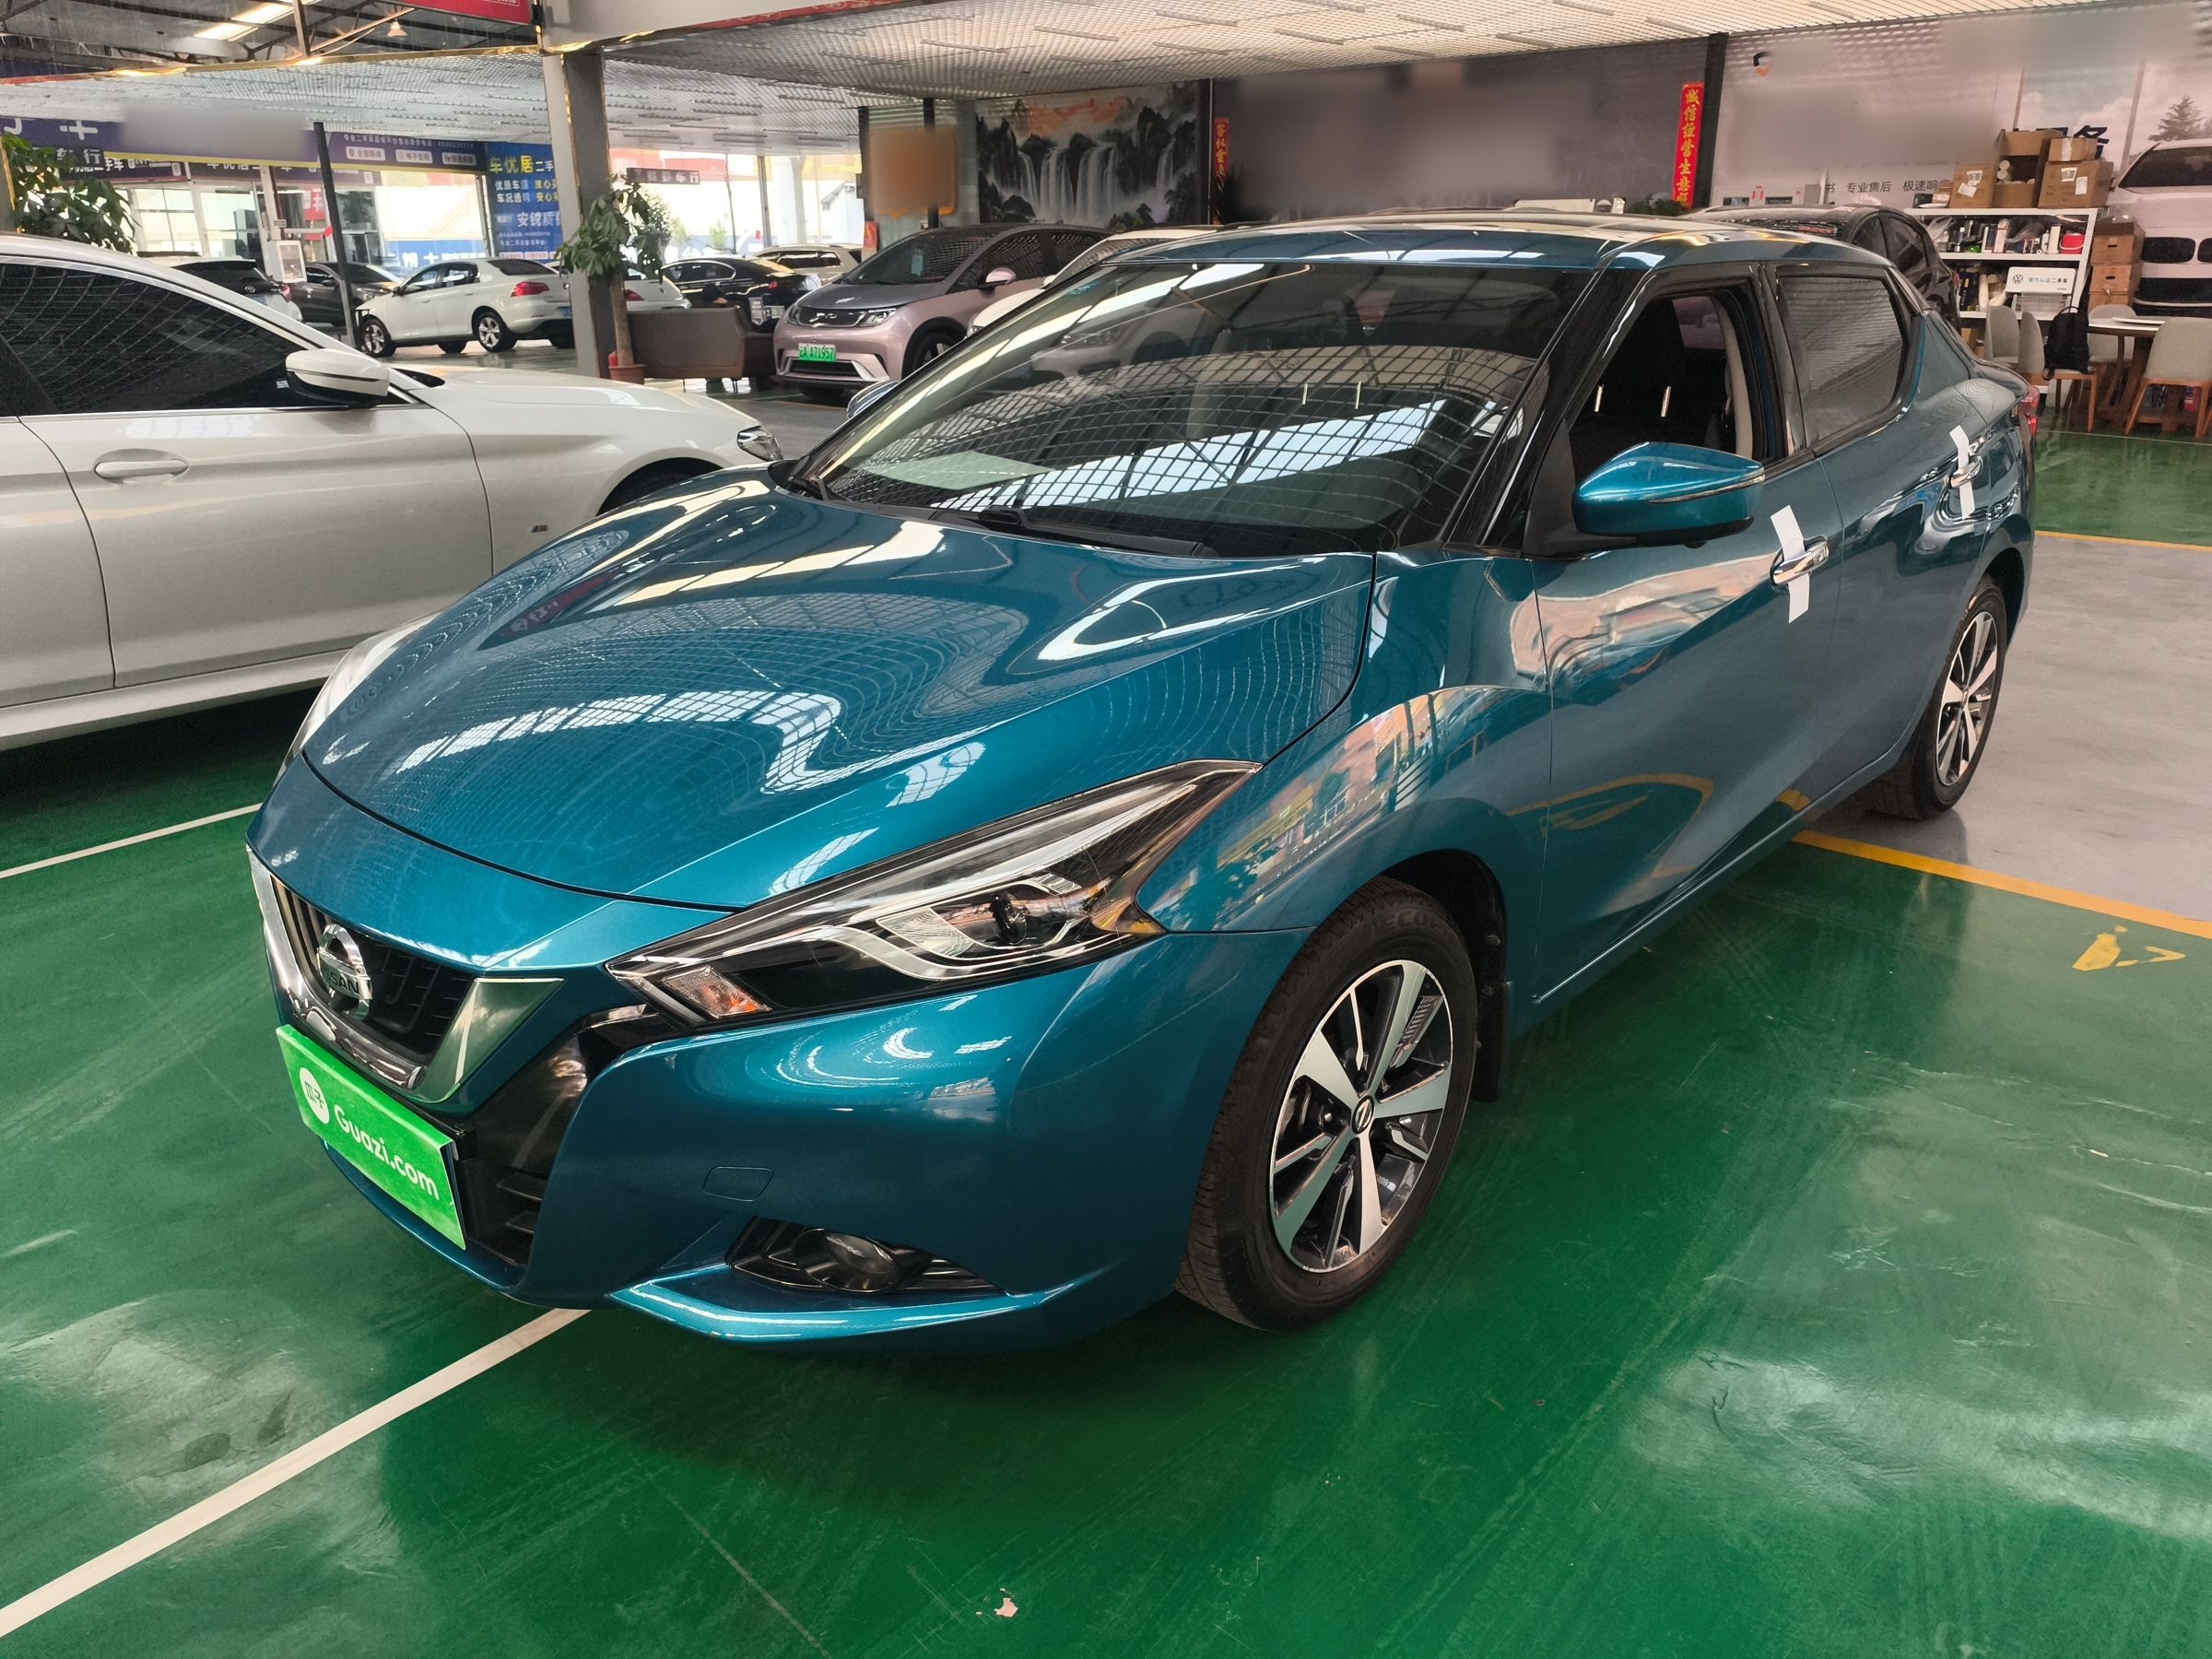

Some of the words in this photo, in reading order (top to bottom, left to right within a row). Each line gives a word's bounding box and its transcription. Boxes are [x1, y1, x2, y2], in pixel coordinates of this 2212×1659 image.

[1846, 181, 1892, 194] 专业售后
[334, 1104, 441, 1201] Guazi.com
